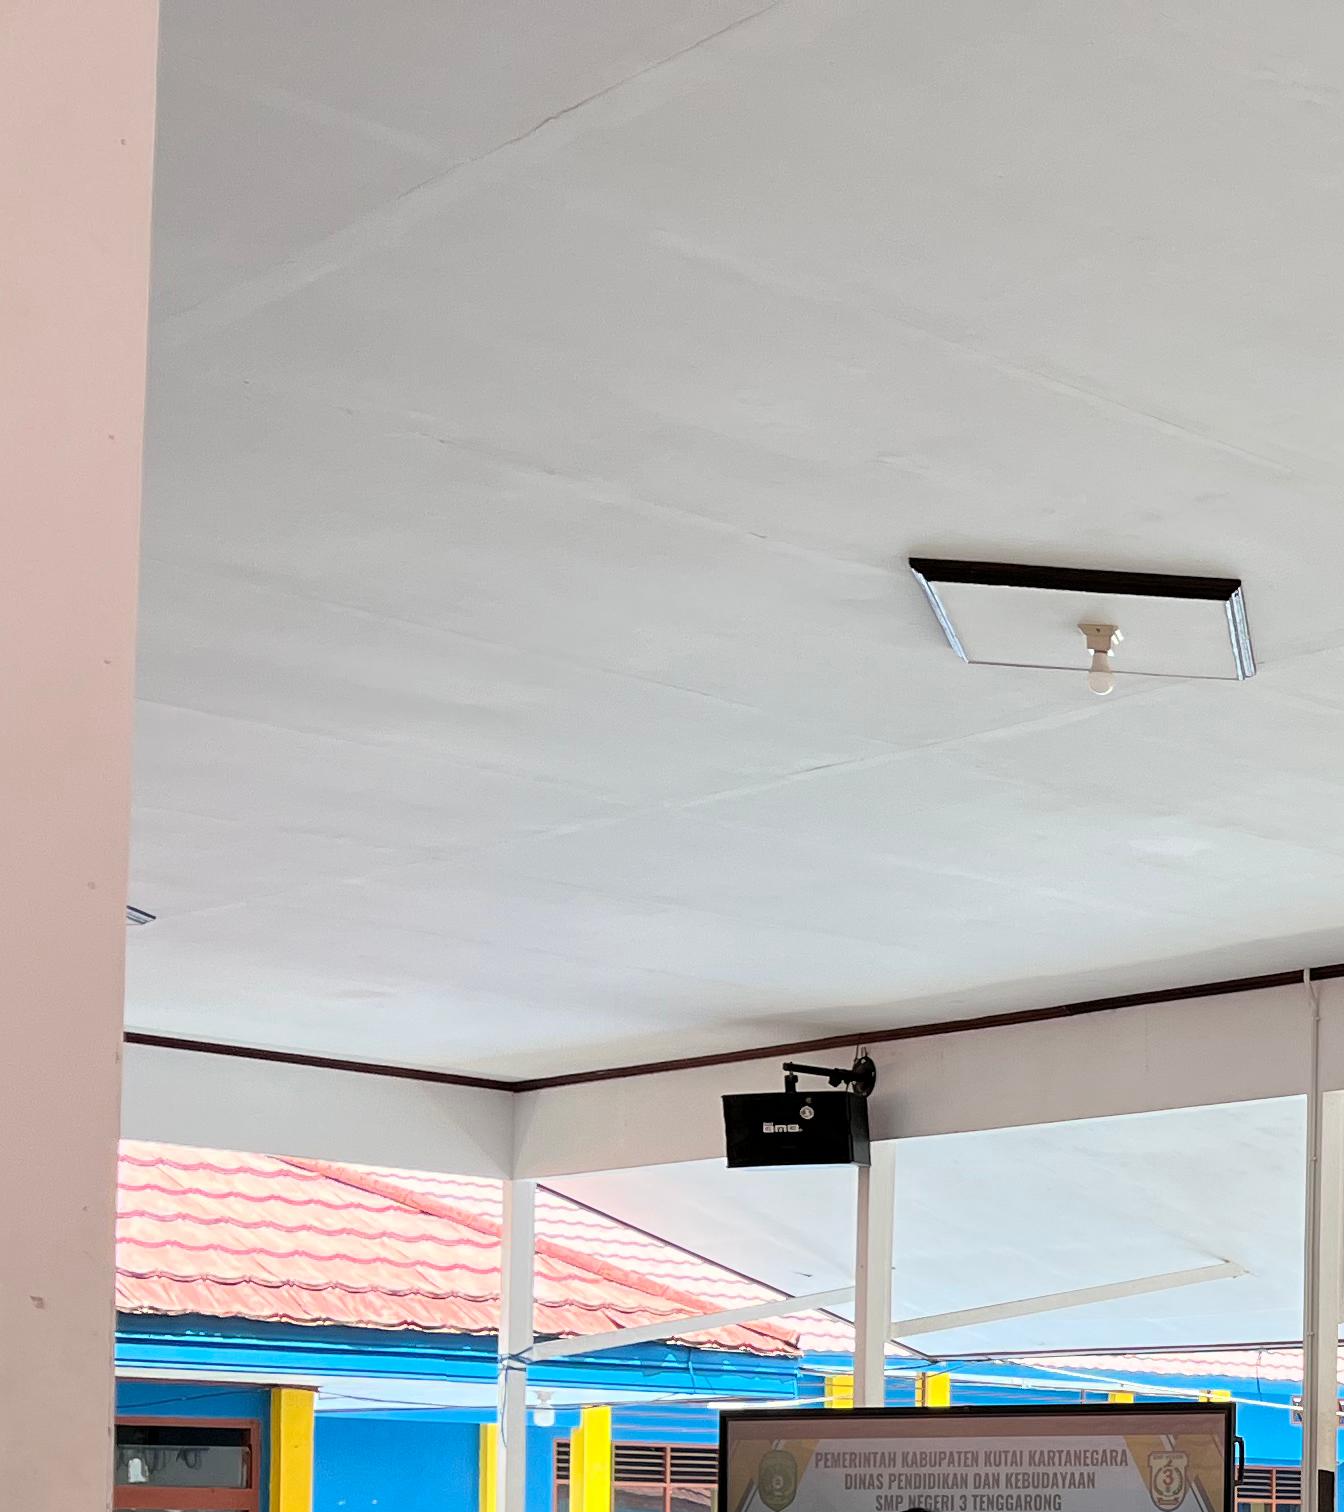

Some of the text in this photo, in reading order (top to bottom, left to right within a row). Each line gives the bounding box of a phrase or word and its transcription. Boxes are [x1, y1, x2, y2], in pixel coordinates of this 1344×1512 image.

[815, 1449, 1128, 1469] PEMERINTAH KABUPATEN KUTAI KARTANEGARA
[845, 1472, 1096, 1490] DINAS PENDIDIKAN DAN KEBUDAYAAN
[875, 1494, 1062, 1512] SMP NEGERI 3 TENGGARONG
